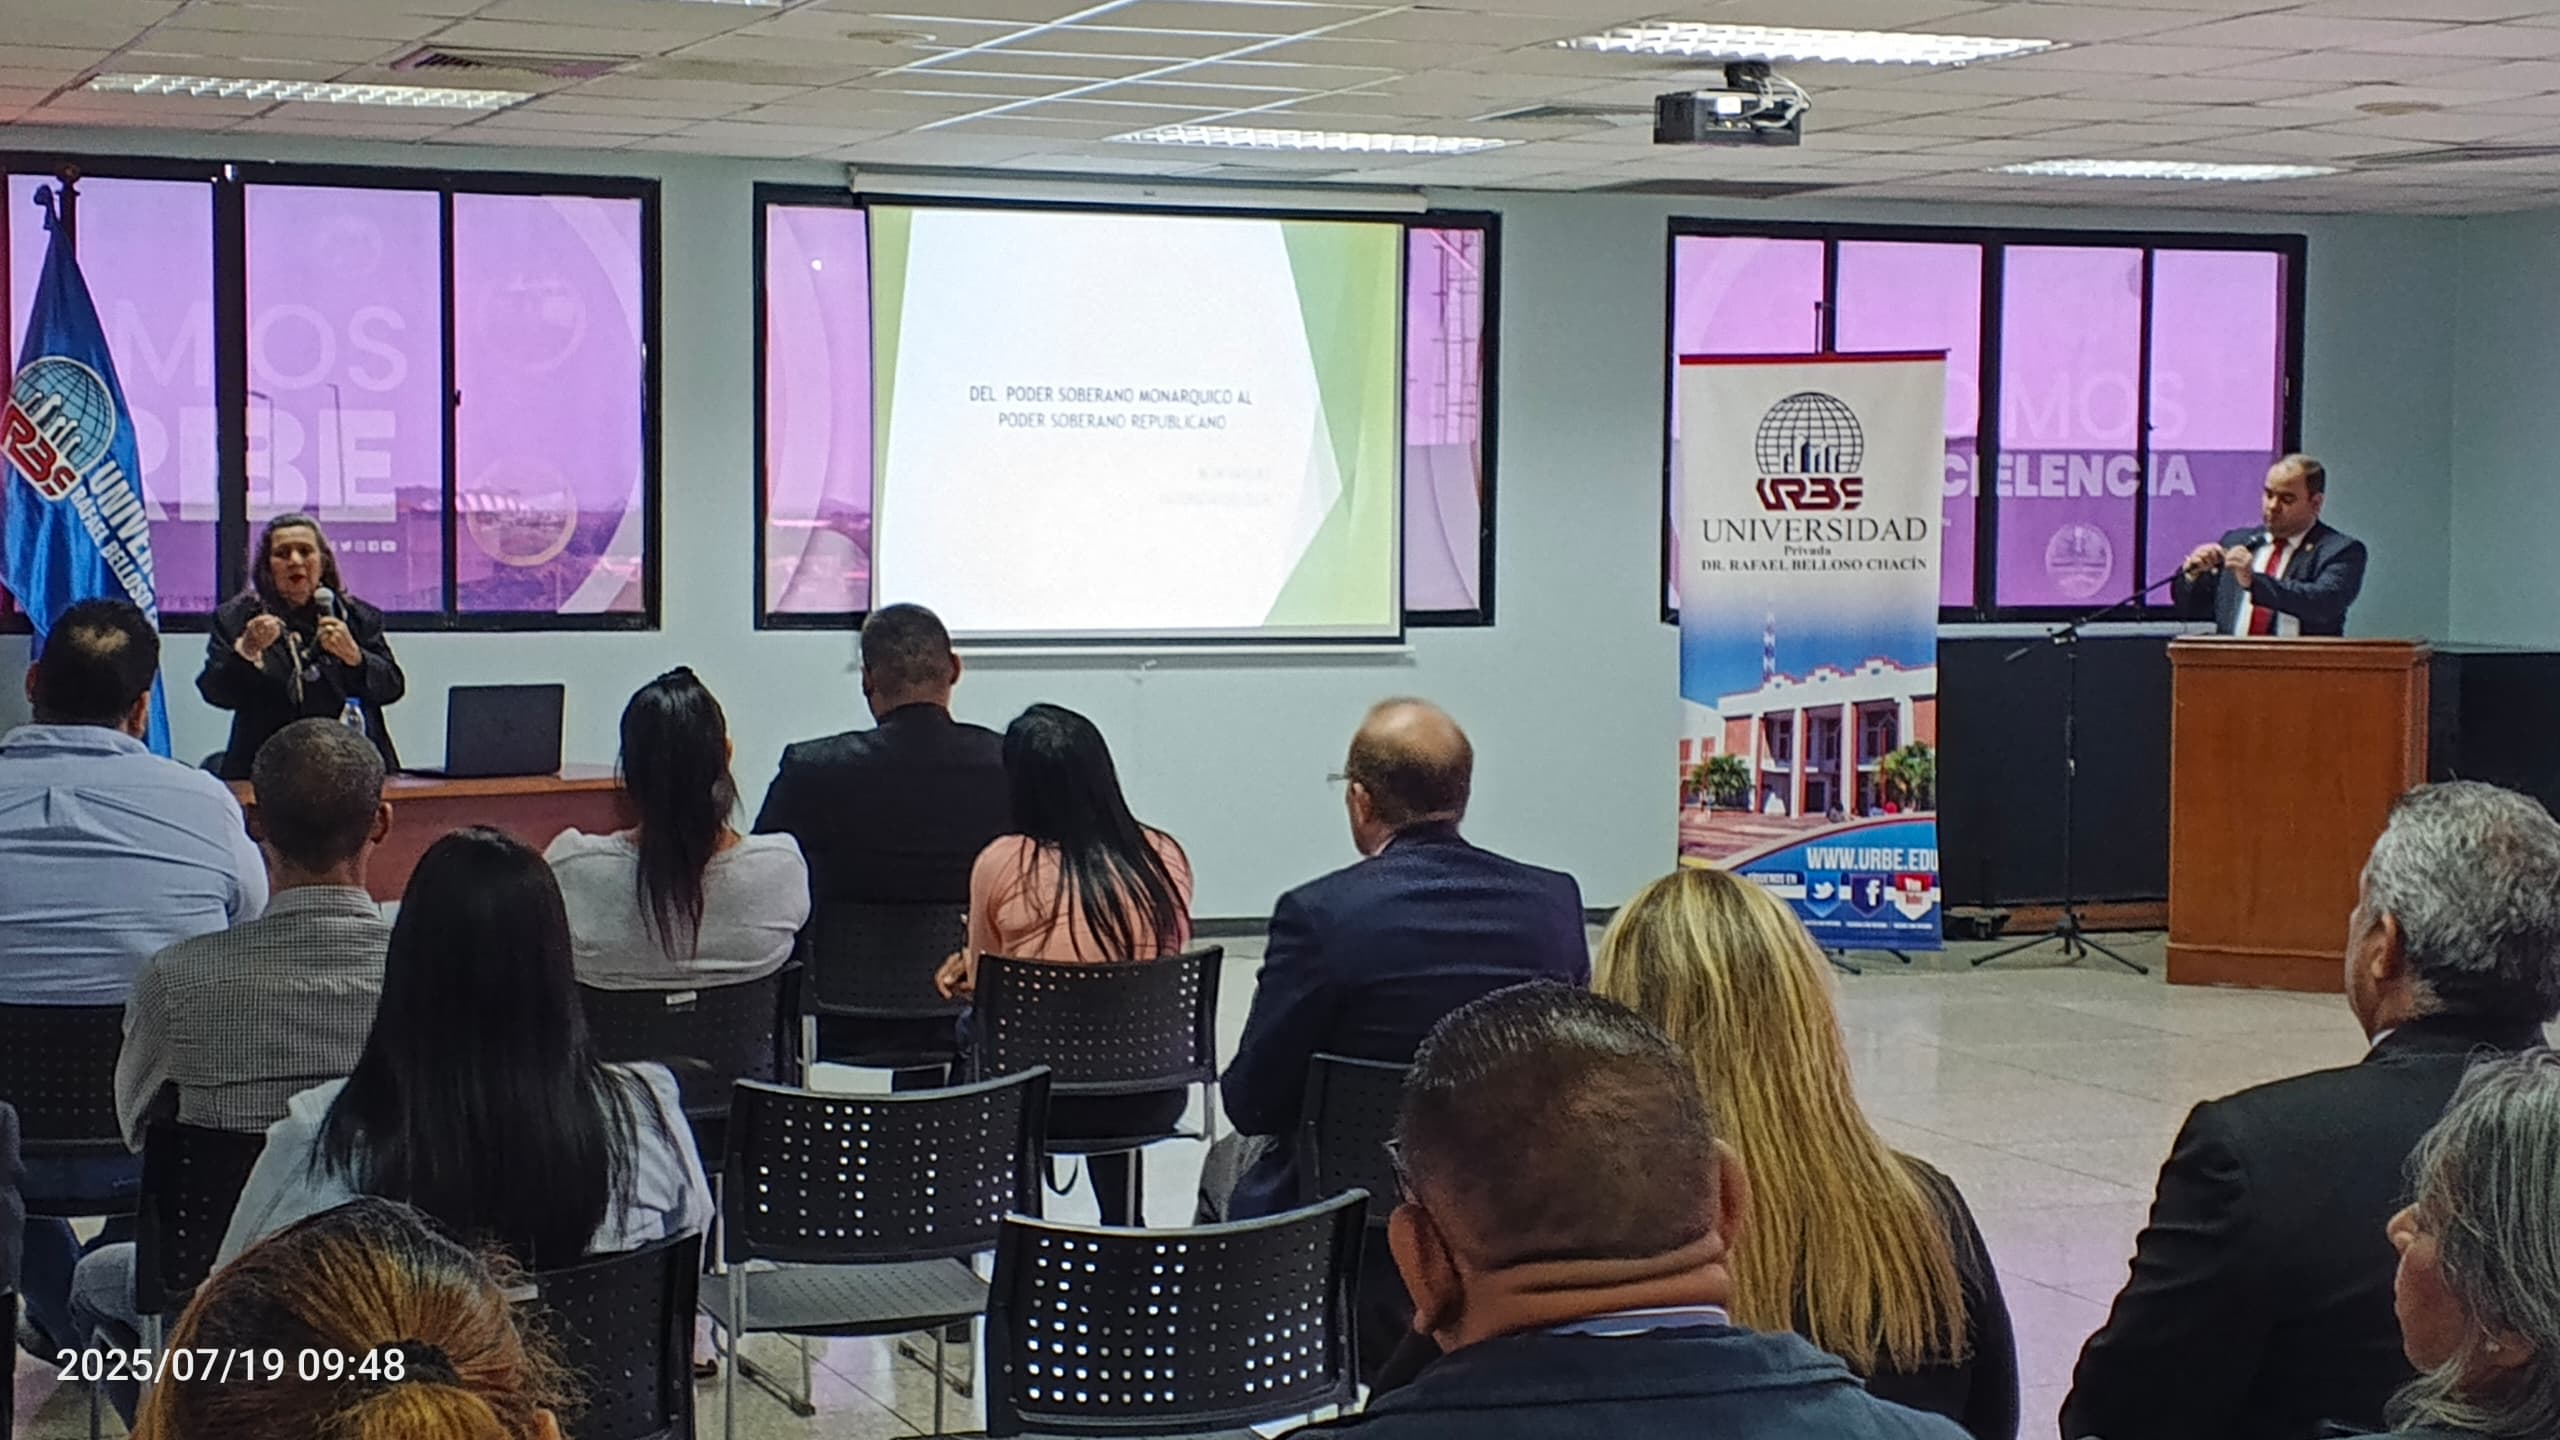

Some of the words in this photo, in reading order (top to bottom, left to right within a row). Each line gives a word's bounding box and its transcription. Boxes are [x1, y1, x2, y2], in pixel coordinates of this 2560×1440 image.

[969, 385, 997, 402] DEL
[1006, 385, 1054, 402] PODER
[1058, 386, 1135, 403] SOBERANO
[1139, 388, 1233, 406] MONARQUICO
[1237, 390, 1253, 405] AL
[998, 411, 1046, 428] PODER
[1050, 412, 1127, 430] SOBERANO
[1131, 413, 1227, 430] REPUBLICANO
[1756, 477, 1864, 512] URBE
[70, 485, 110, 549] RAFAEL
[1702, 516, 1928, 543] UNIVERSIDAD
[1784, 544, 1832, 557] Privada
[1702, 559, 1725, 572] DR.
[1730, 559, 1785, 571] RAFAEL
[1792, 558, 1863, 571] BELLOSO
[1866, 556, 1928, 571] CHACÍN
